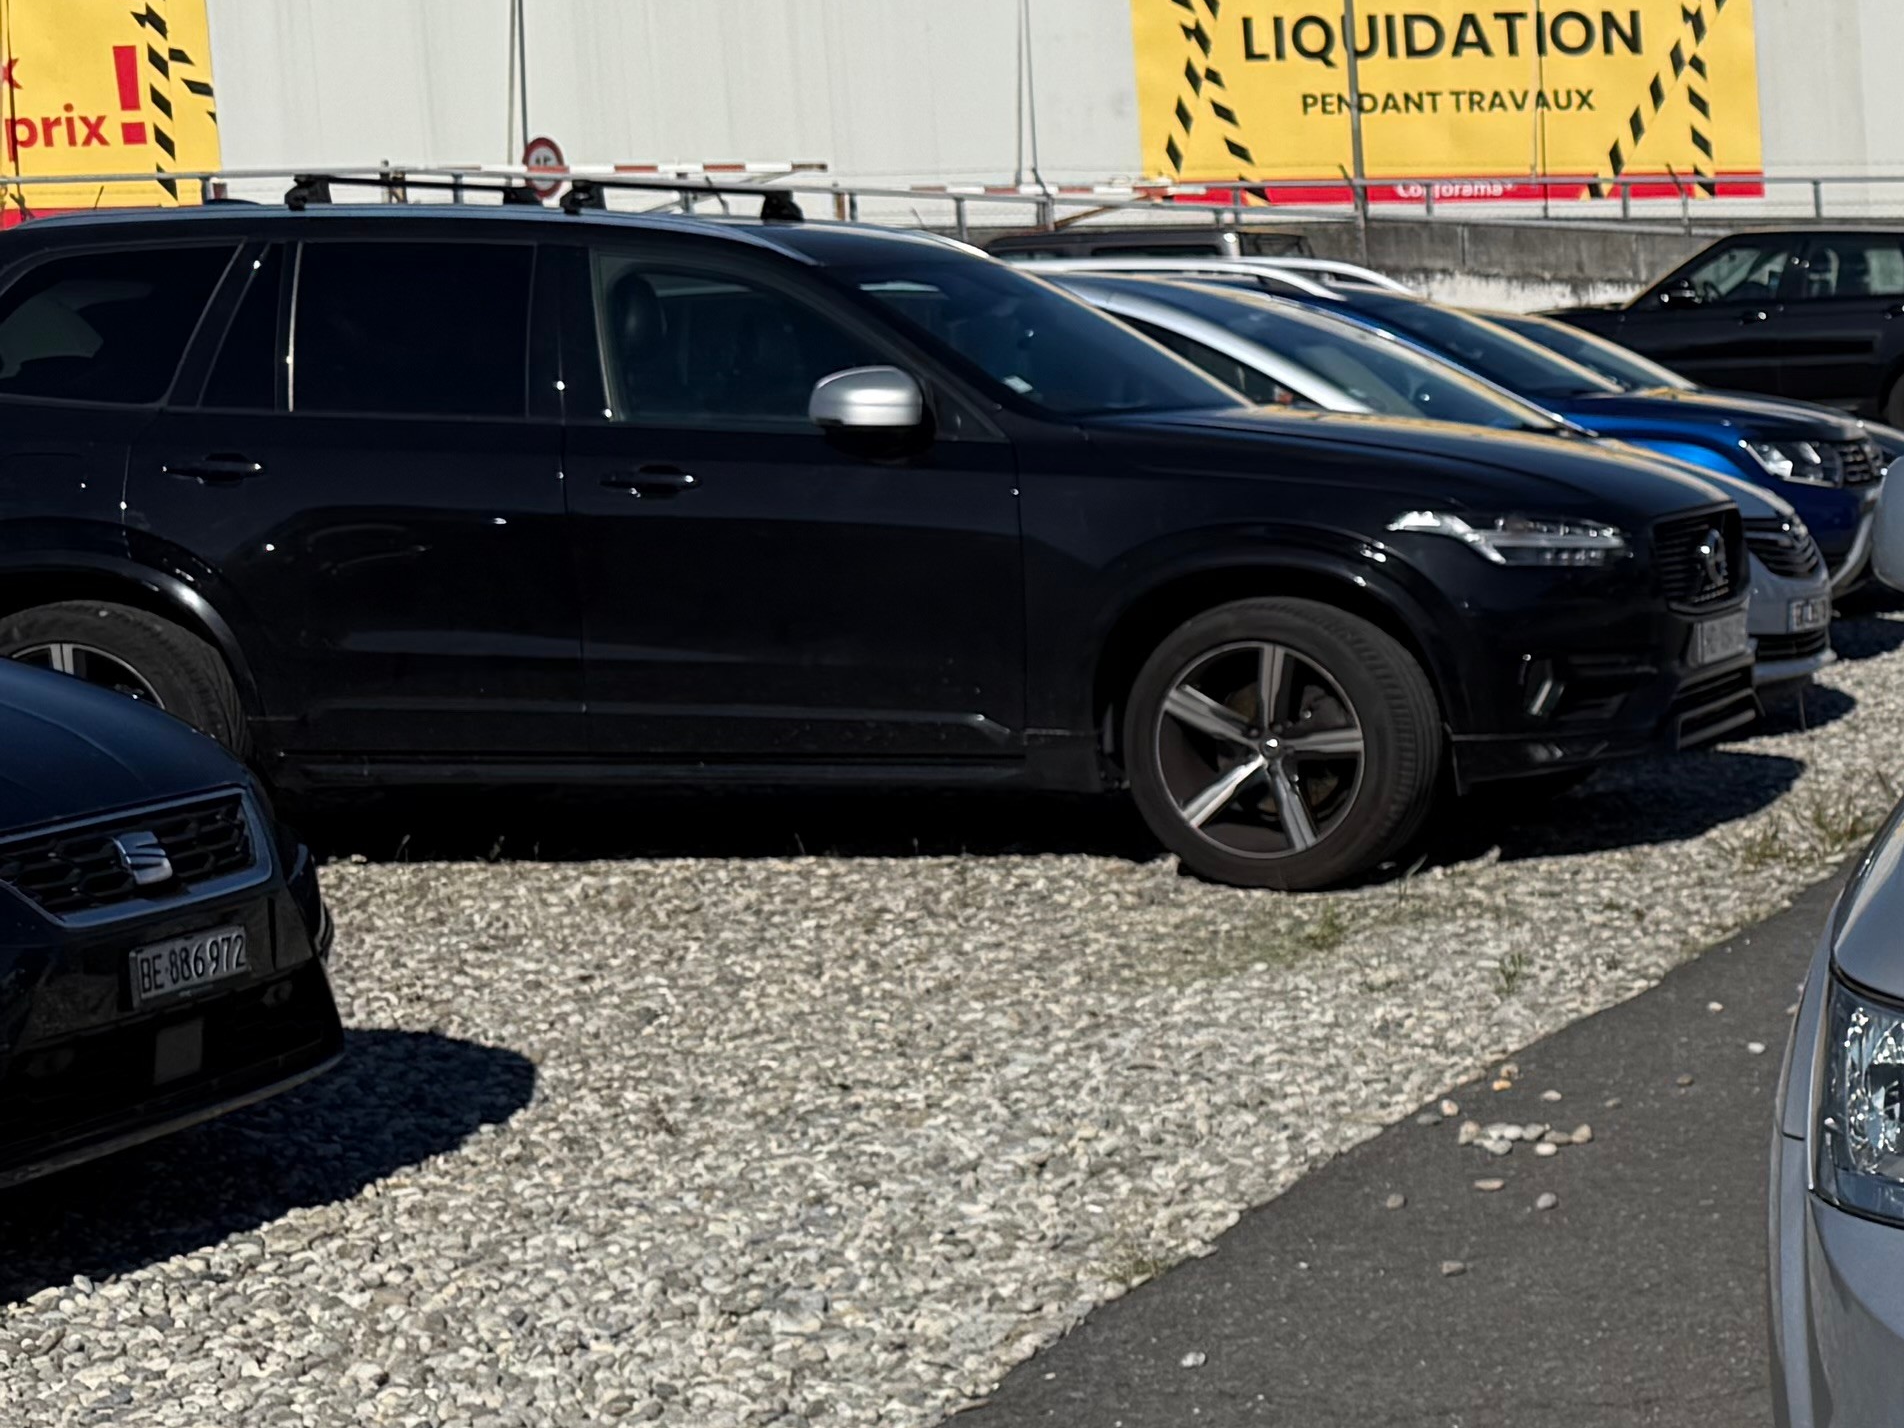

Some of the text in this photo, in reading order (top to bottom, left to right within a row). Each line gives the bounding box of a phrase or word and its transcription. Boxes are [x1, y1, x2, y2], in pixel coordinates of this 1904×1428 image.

[1241, 9, 1643, 69] LIQUIDATION
[1450, 88, 1596, 113] TRAVAUX
[4, 102, 110, 163] prix
